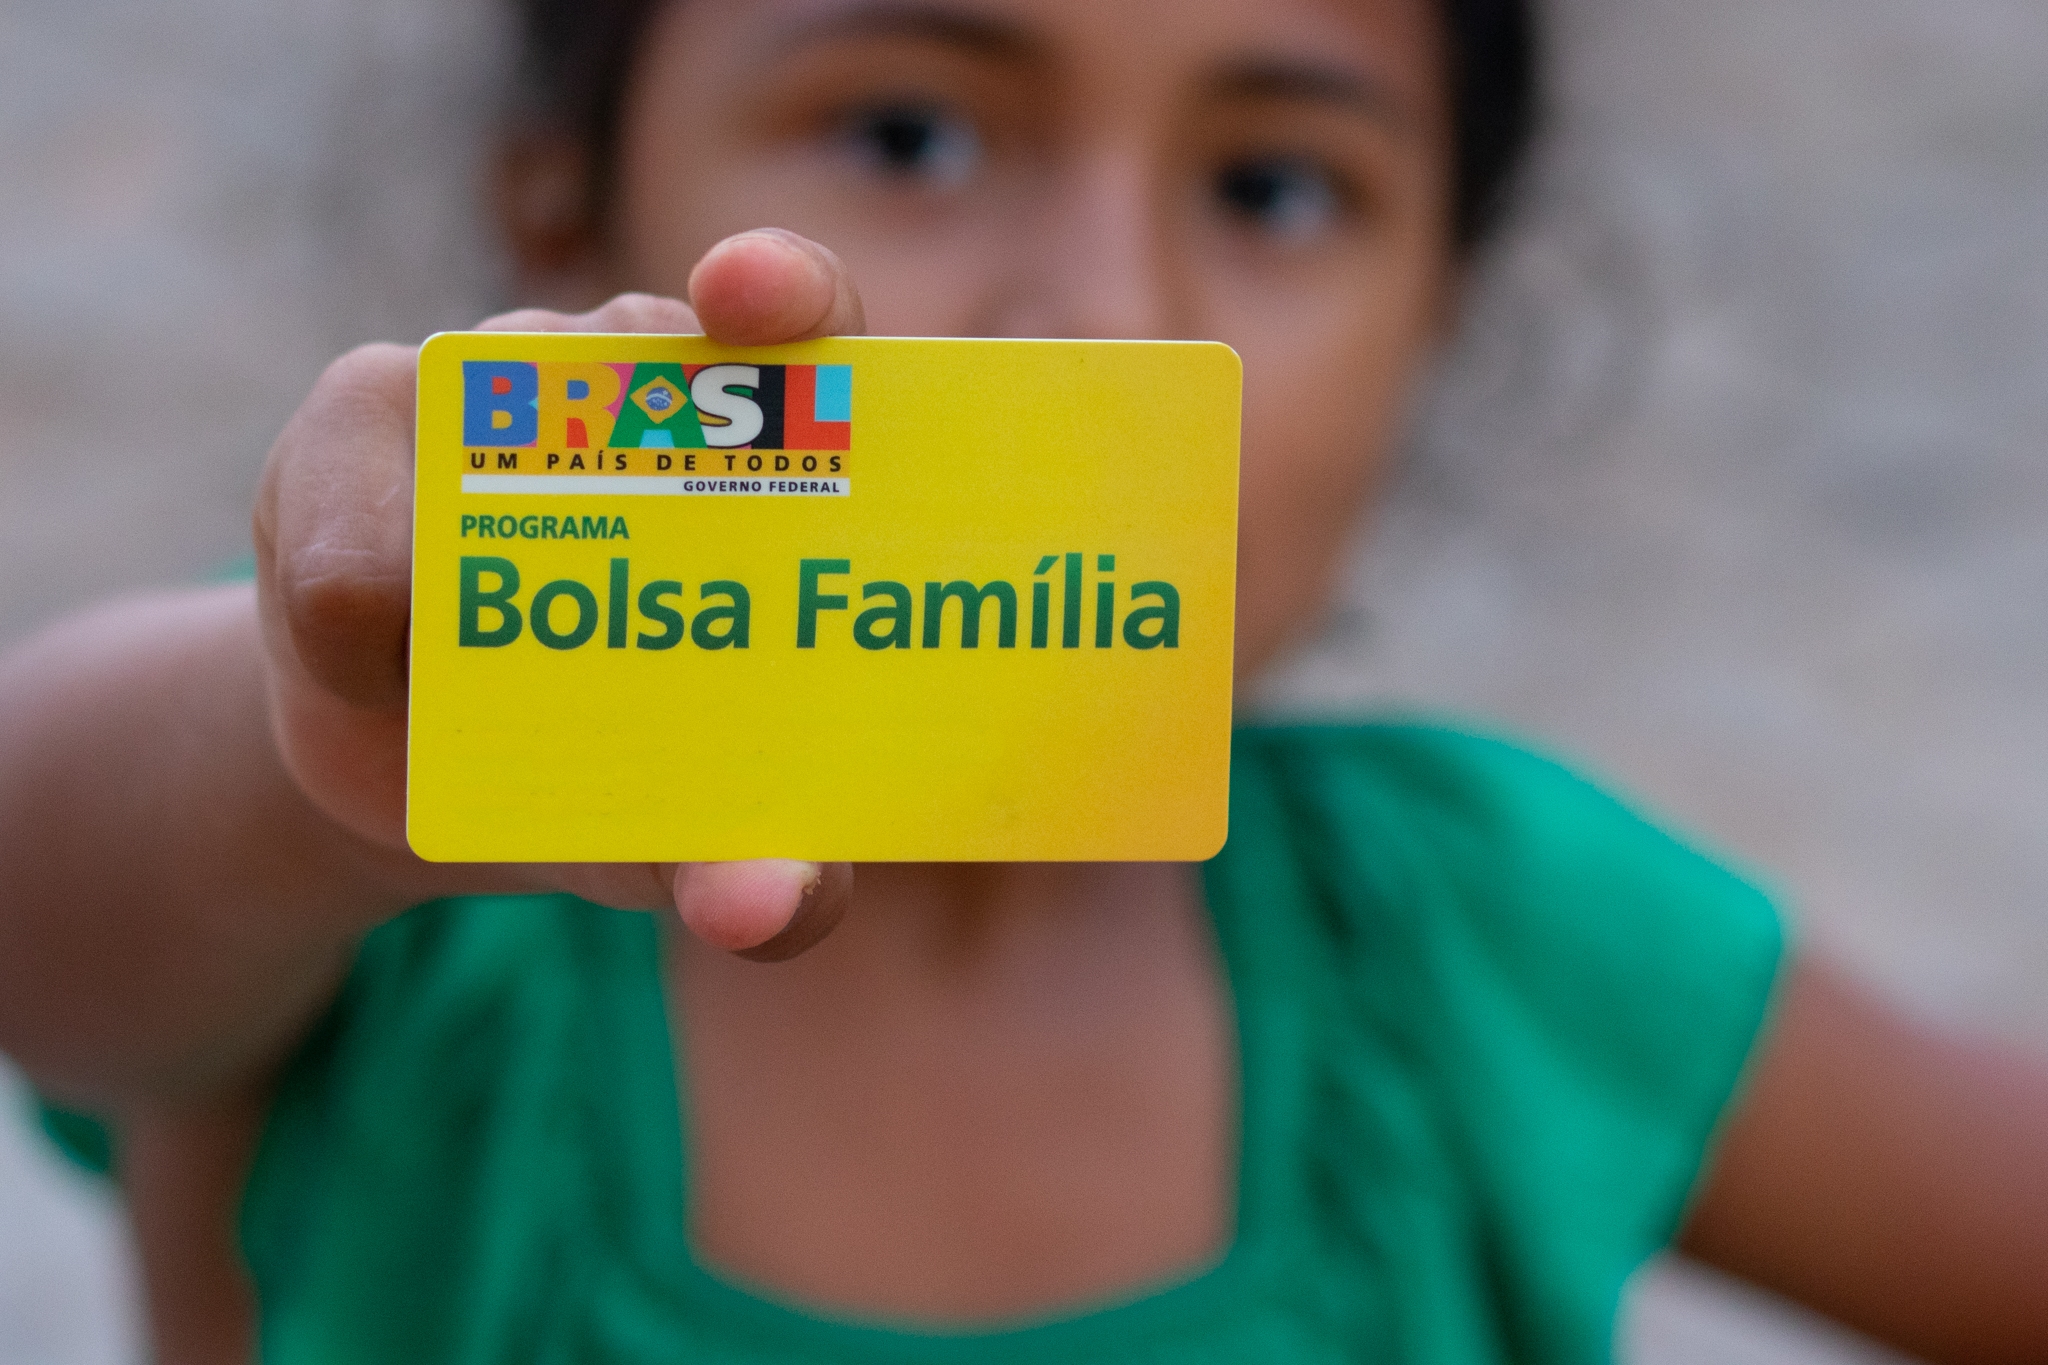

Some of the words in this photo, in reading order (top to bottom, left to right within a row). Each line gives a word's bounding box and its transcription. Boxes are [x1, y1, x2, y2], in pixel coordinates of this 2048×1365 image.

[463, 361, 852, 450] BRASIL
[471, 453, 518, 469] UM
[547, 451, 628, 470] PAÍS
[657, 455, 697, 471] DE
[725, 455, 842, 472] TODOS
[683, 481, 762, 493] GOVERNO
[769, 481, 840, 493] FEDERAL
[461, 514, 630, 539] PROGRAMA
[458, 556, 750, 650] Bolsa
[796, 552, 1179, 650] Família
